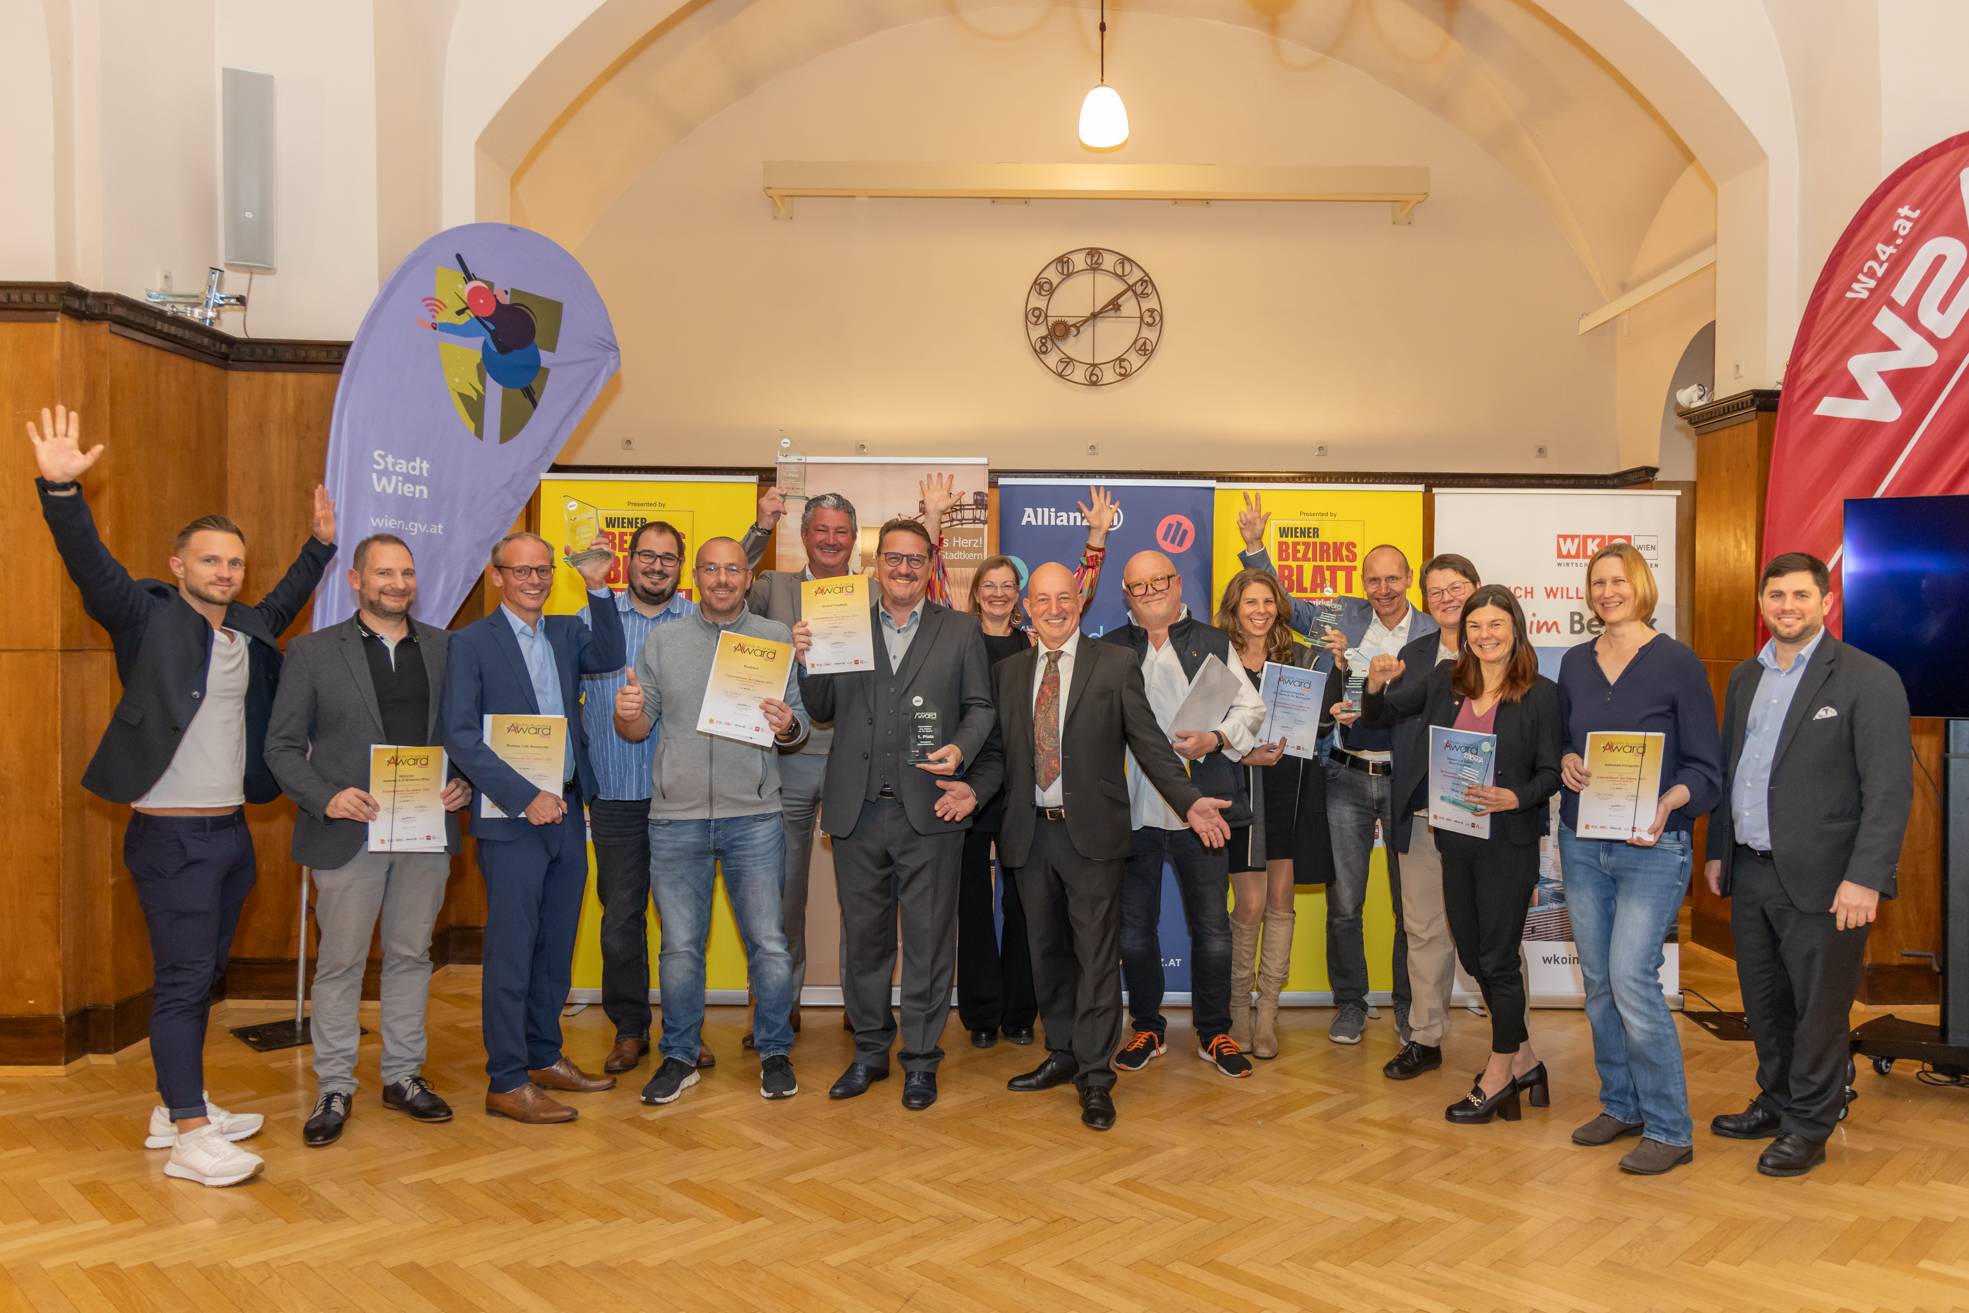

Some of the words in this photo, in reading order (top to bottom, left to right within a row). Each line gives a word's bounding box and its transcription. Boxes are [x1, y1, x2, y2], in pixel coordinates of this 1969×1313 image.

[1087, 251, 1101, 267] 12
[1845, 205, 1921, 300] W24.at
[1058, 258, 1071, 276] 11
[1119, 260, 1126, 277] 1
[1036, 280, 1052, 296] 10
[1139, 281, 1149, 297] 2
[1031, 307, 1042, 325] 9
[1145, 309, 1156, 327] 3
[1039, 337, 1049, 355] 8
[1138, 339, 1150, 355] 4
[1059, 360, 1071, 376] 7
[1089, 366, 1099, 385] 6
[1118, 358, 1128, 377] 5
[372, 450, 430, 477] Stadt
[371, 472, 428, 499] Wien
[370, 515, 444, 536] wien.gv.at
[1278, 526, 1320, 539] WIENER
[953, 536, 983, 548] Herz!
[1277, 541, 1357, 563] BEZIRKS
[1277, 564, 1357, 594] BLATT
[814, 582, 854, 596] Award
[1544, 586, 1585, 600] WILL
[1529, 612, 1561, 635] im
[733, 643, 776, 660] Award
[1277, 674, 1312, 689] Award
[506, 722, 552, 736] Award
[1443, 739, 1479, 755] Award
[1602, 741, 1647, 754] Award
[386, 755, 430, 767] Award
